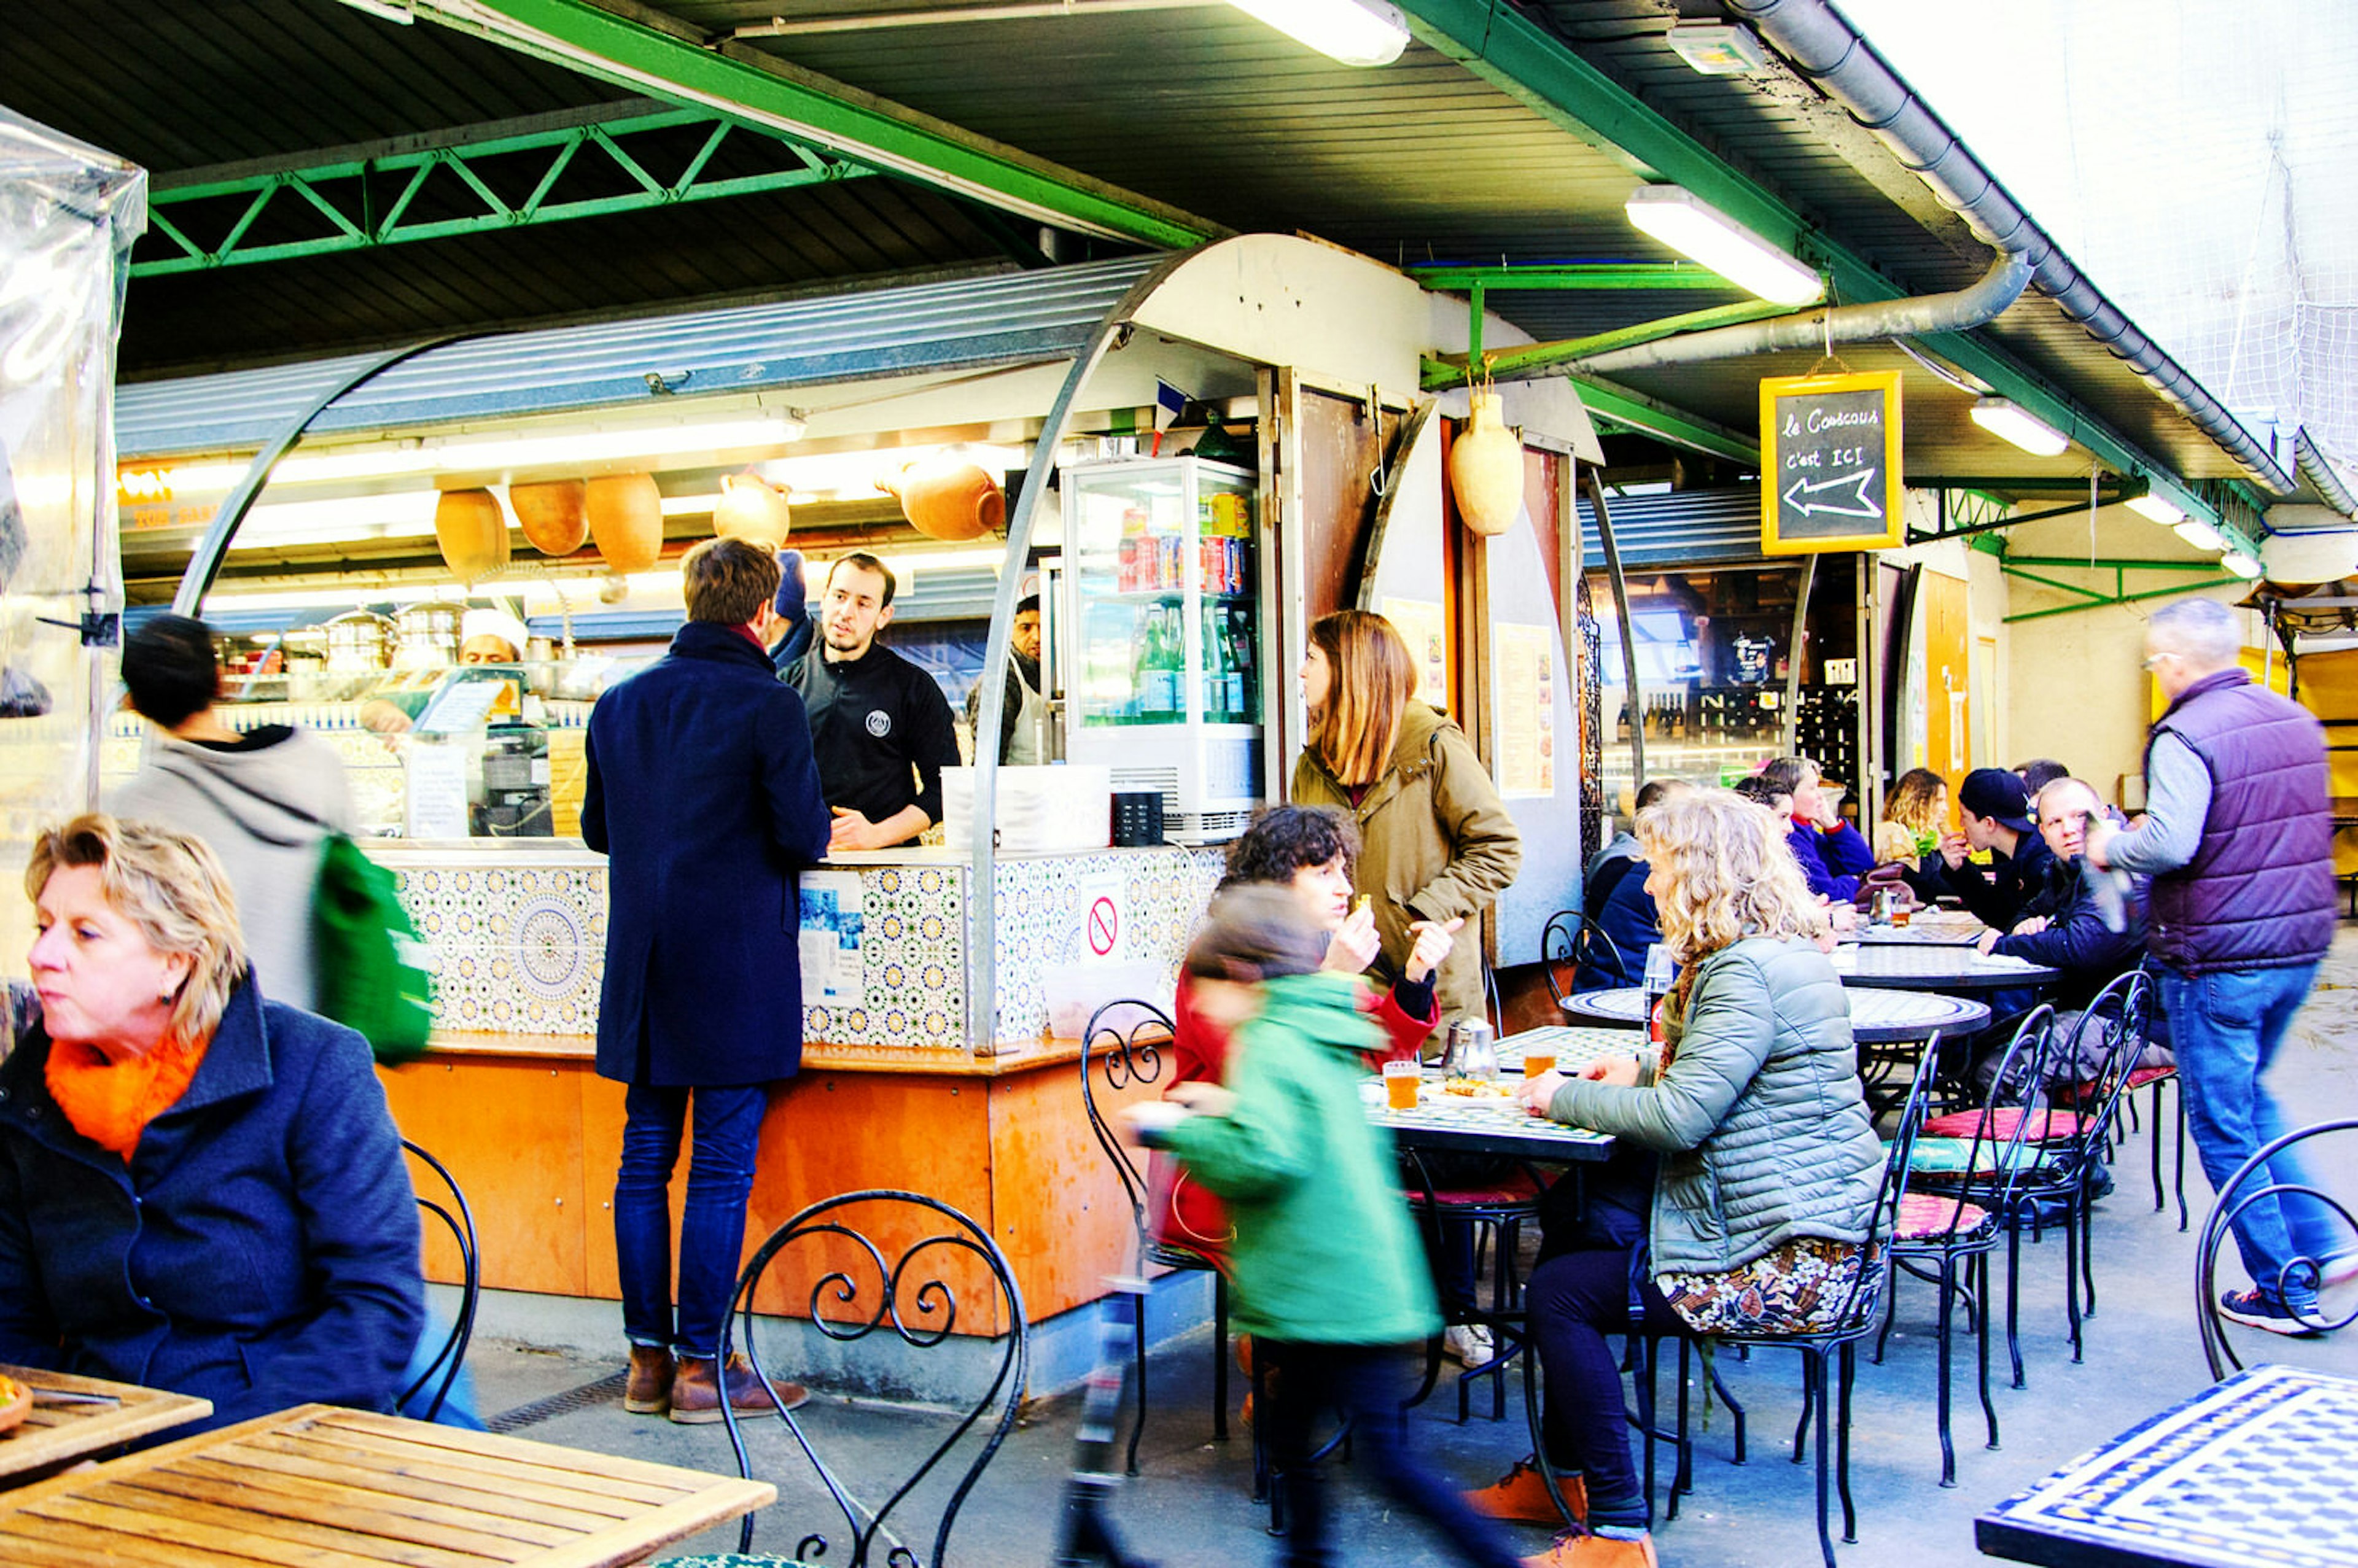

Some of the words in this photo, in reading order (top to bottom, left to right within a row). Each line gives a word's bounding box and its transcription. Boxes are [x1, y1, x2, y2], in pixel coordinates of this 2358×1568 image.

[1807, 408, 1880, 433] Couscous
[1786, 449, 1821, 470] c'est
[1831, 447, 1863, 467] ICI
